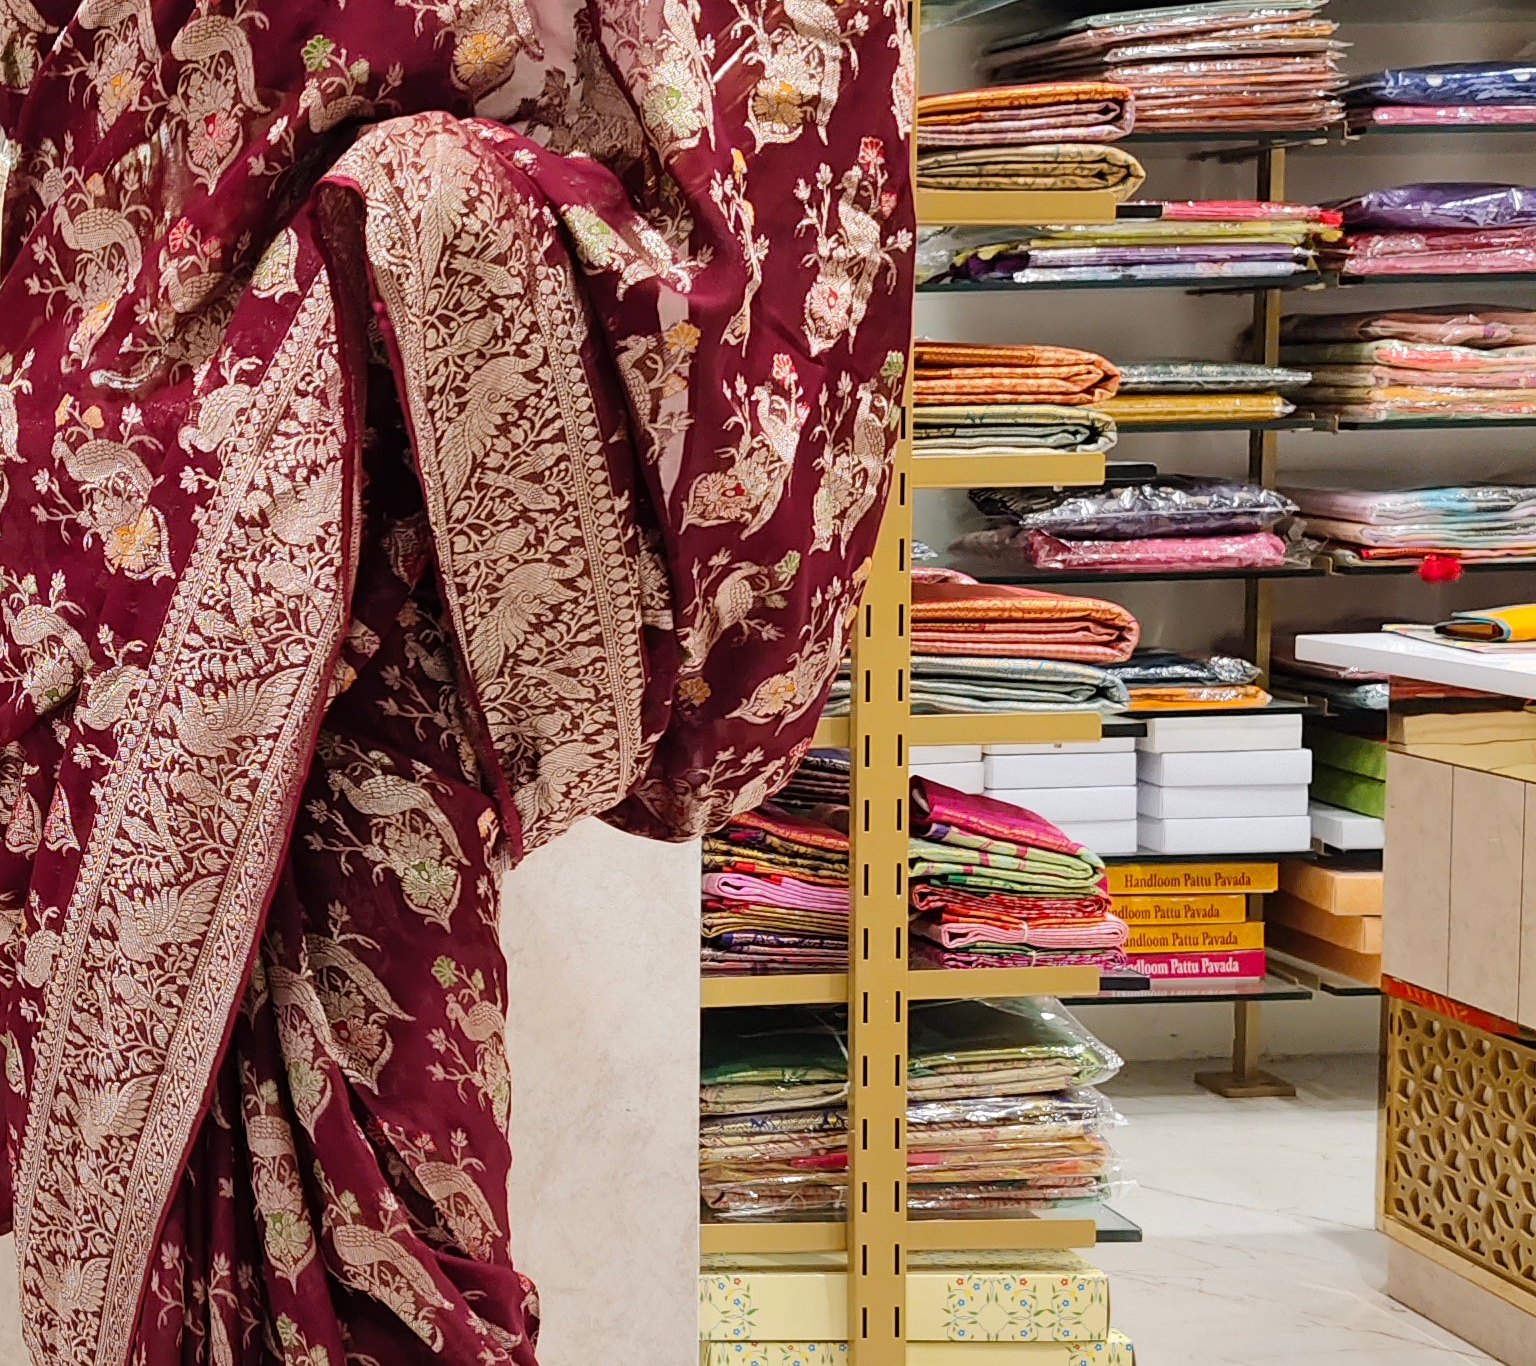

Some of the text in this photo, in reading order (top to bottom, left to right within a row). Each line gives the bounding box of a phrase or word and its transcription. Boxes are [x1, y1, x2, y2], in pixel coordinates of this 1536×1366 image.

[1124, 872, 1251, 888] Handloom Pattu Pavada
[1109, 904, 1220, 920] ndloom Pattu Pavada
[1120, 931, 1238, 947] andloom Pattu Pavada
[1123, 956, 1240, 975] ndloom Pattu Pavada
